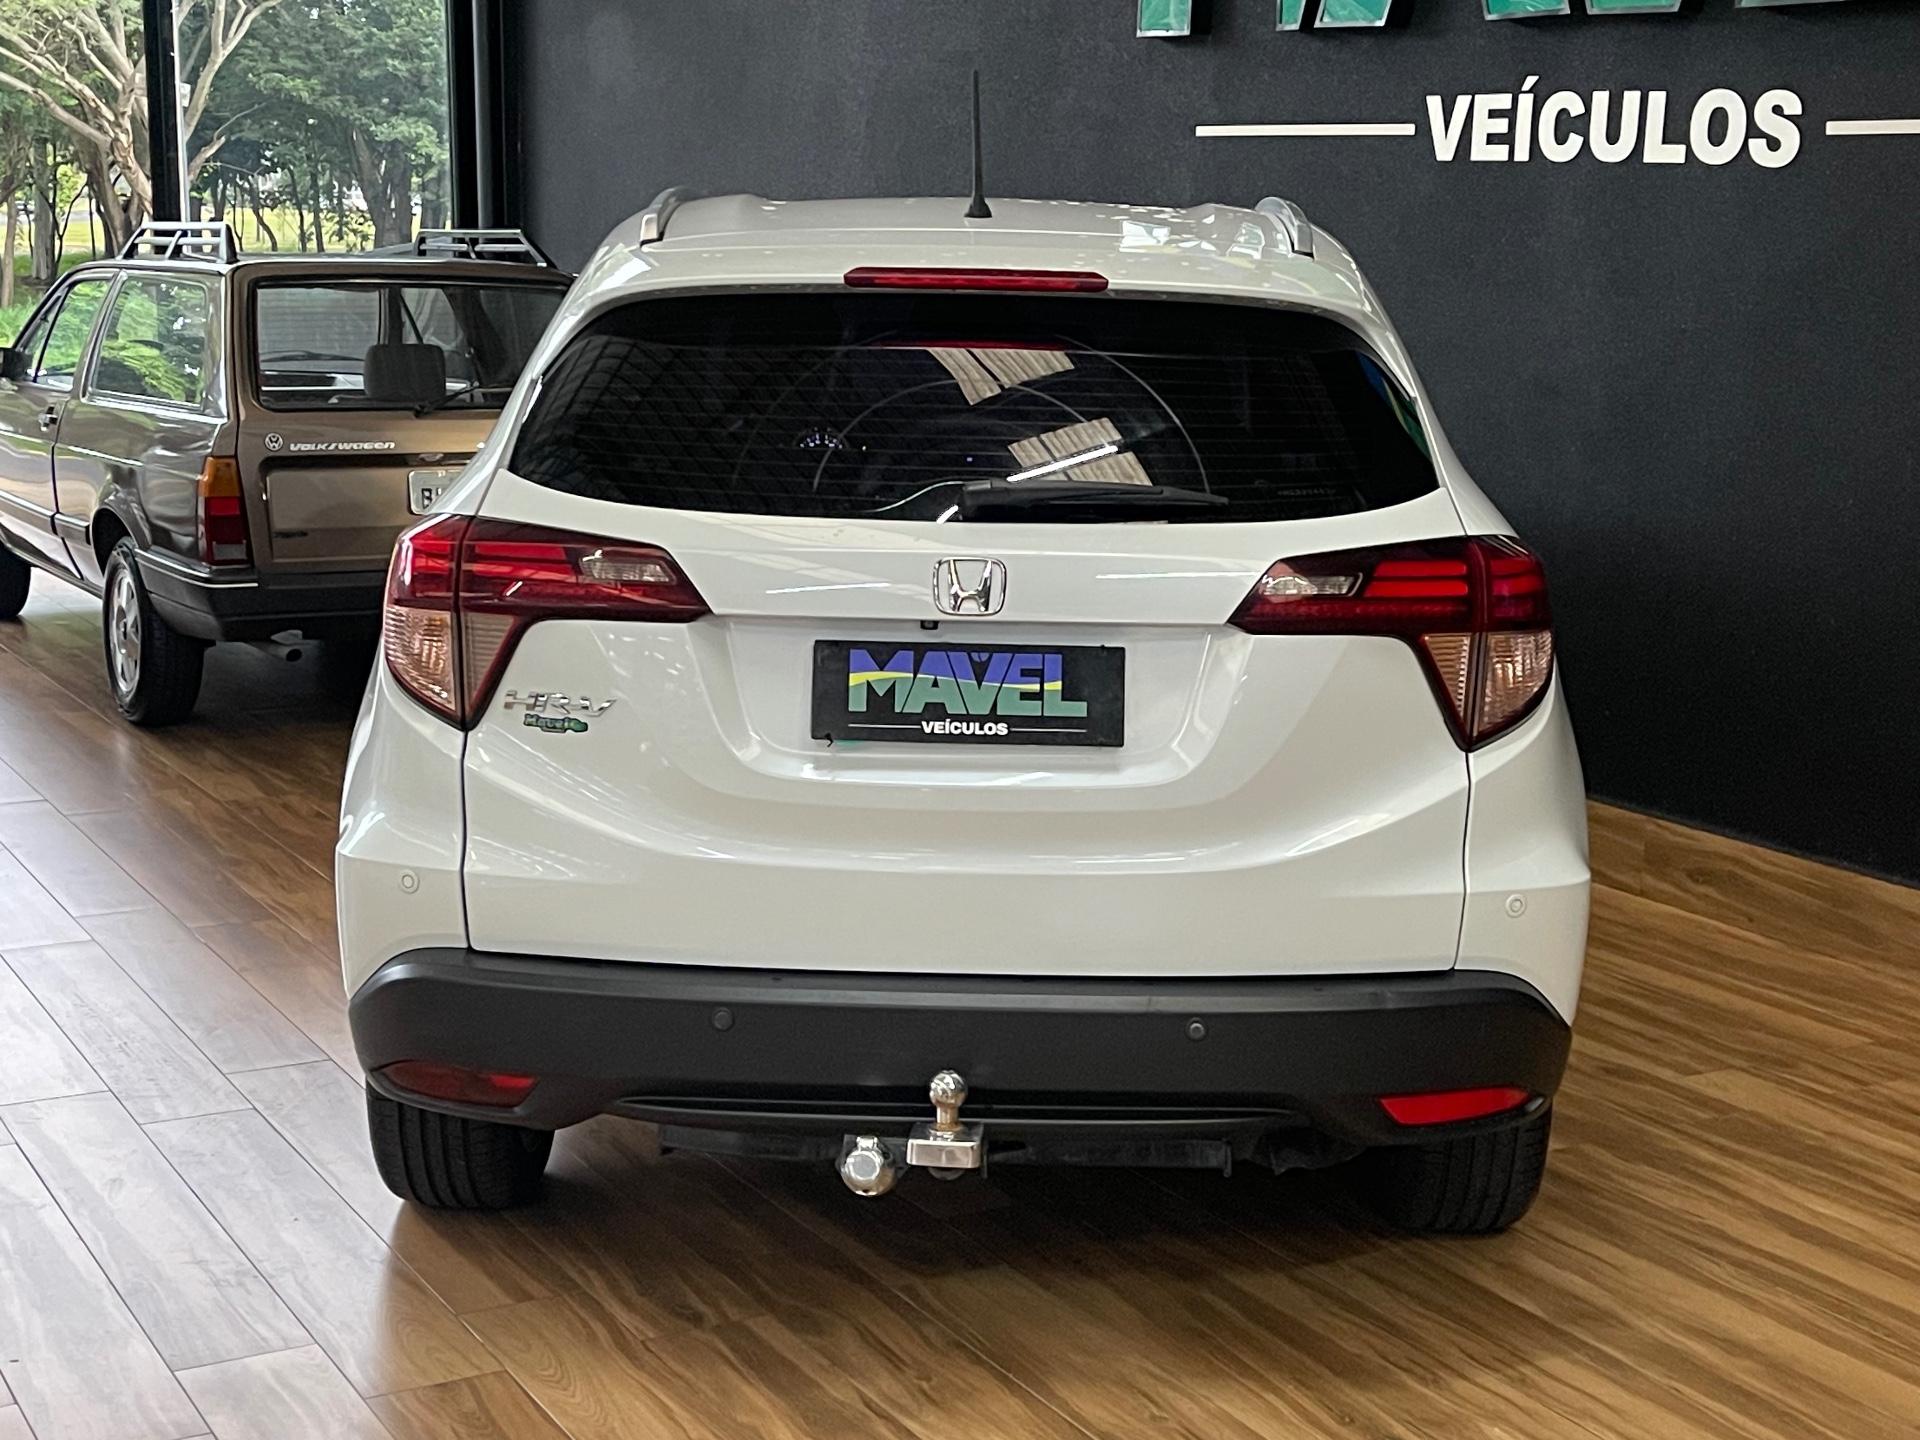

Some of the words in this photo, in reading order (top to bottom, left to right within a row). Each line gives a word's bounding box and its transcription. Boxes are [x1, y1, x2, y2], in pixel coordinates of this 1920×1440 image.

[1425, 75, 1803, 168] VEÍCULOS
[848, 649, 1088, 717] MAVEL
[921, 718, 1009, 735] VEÍCULOS
